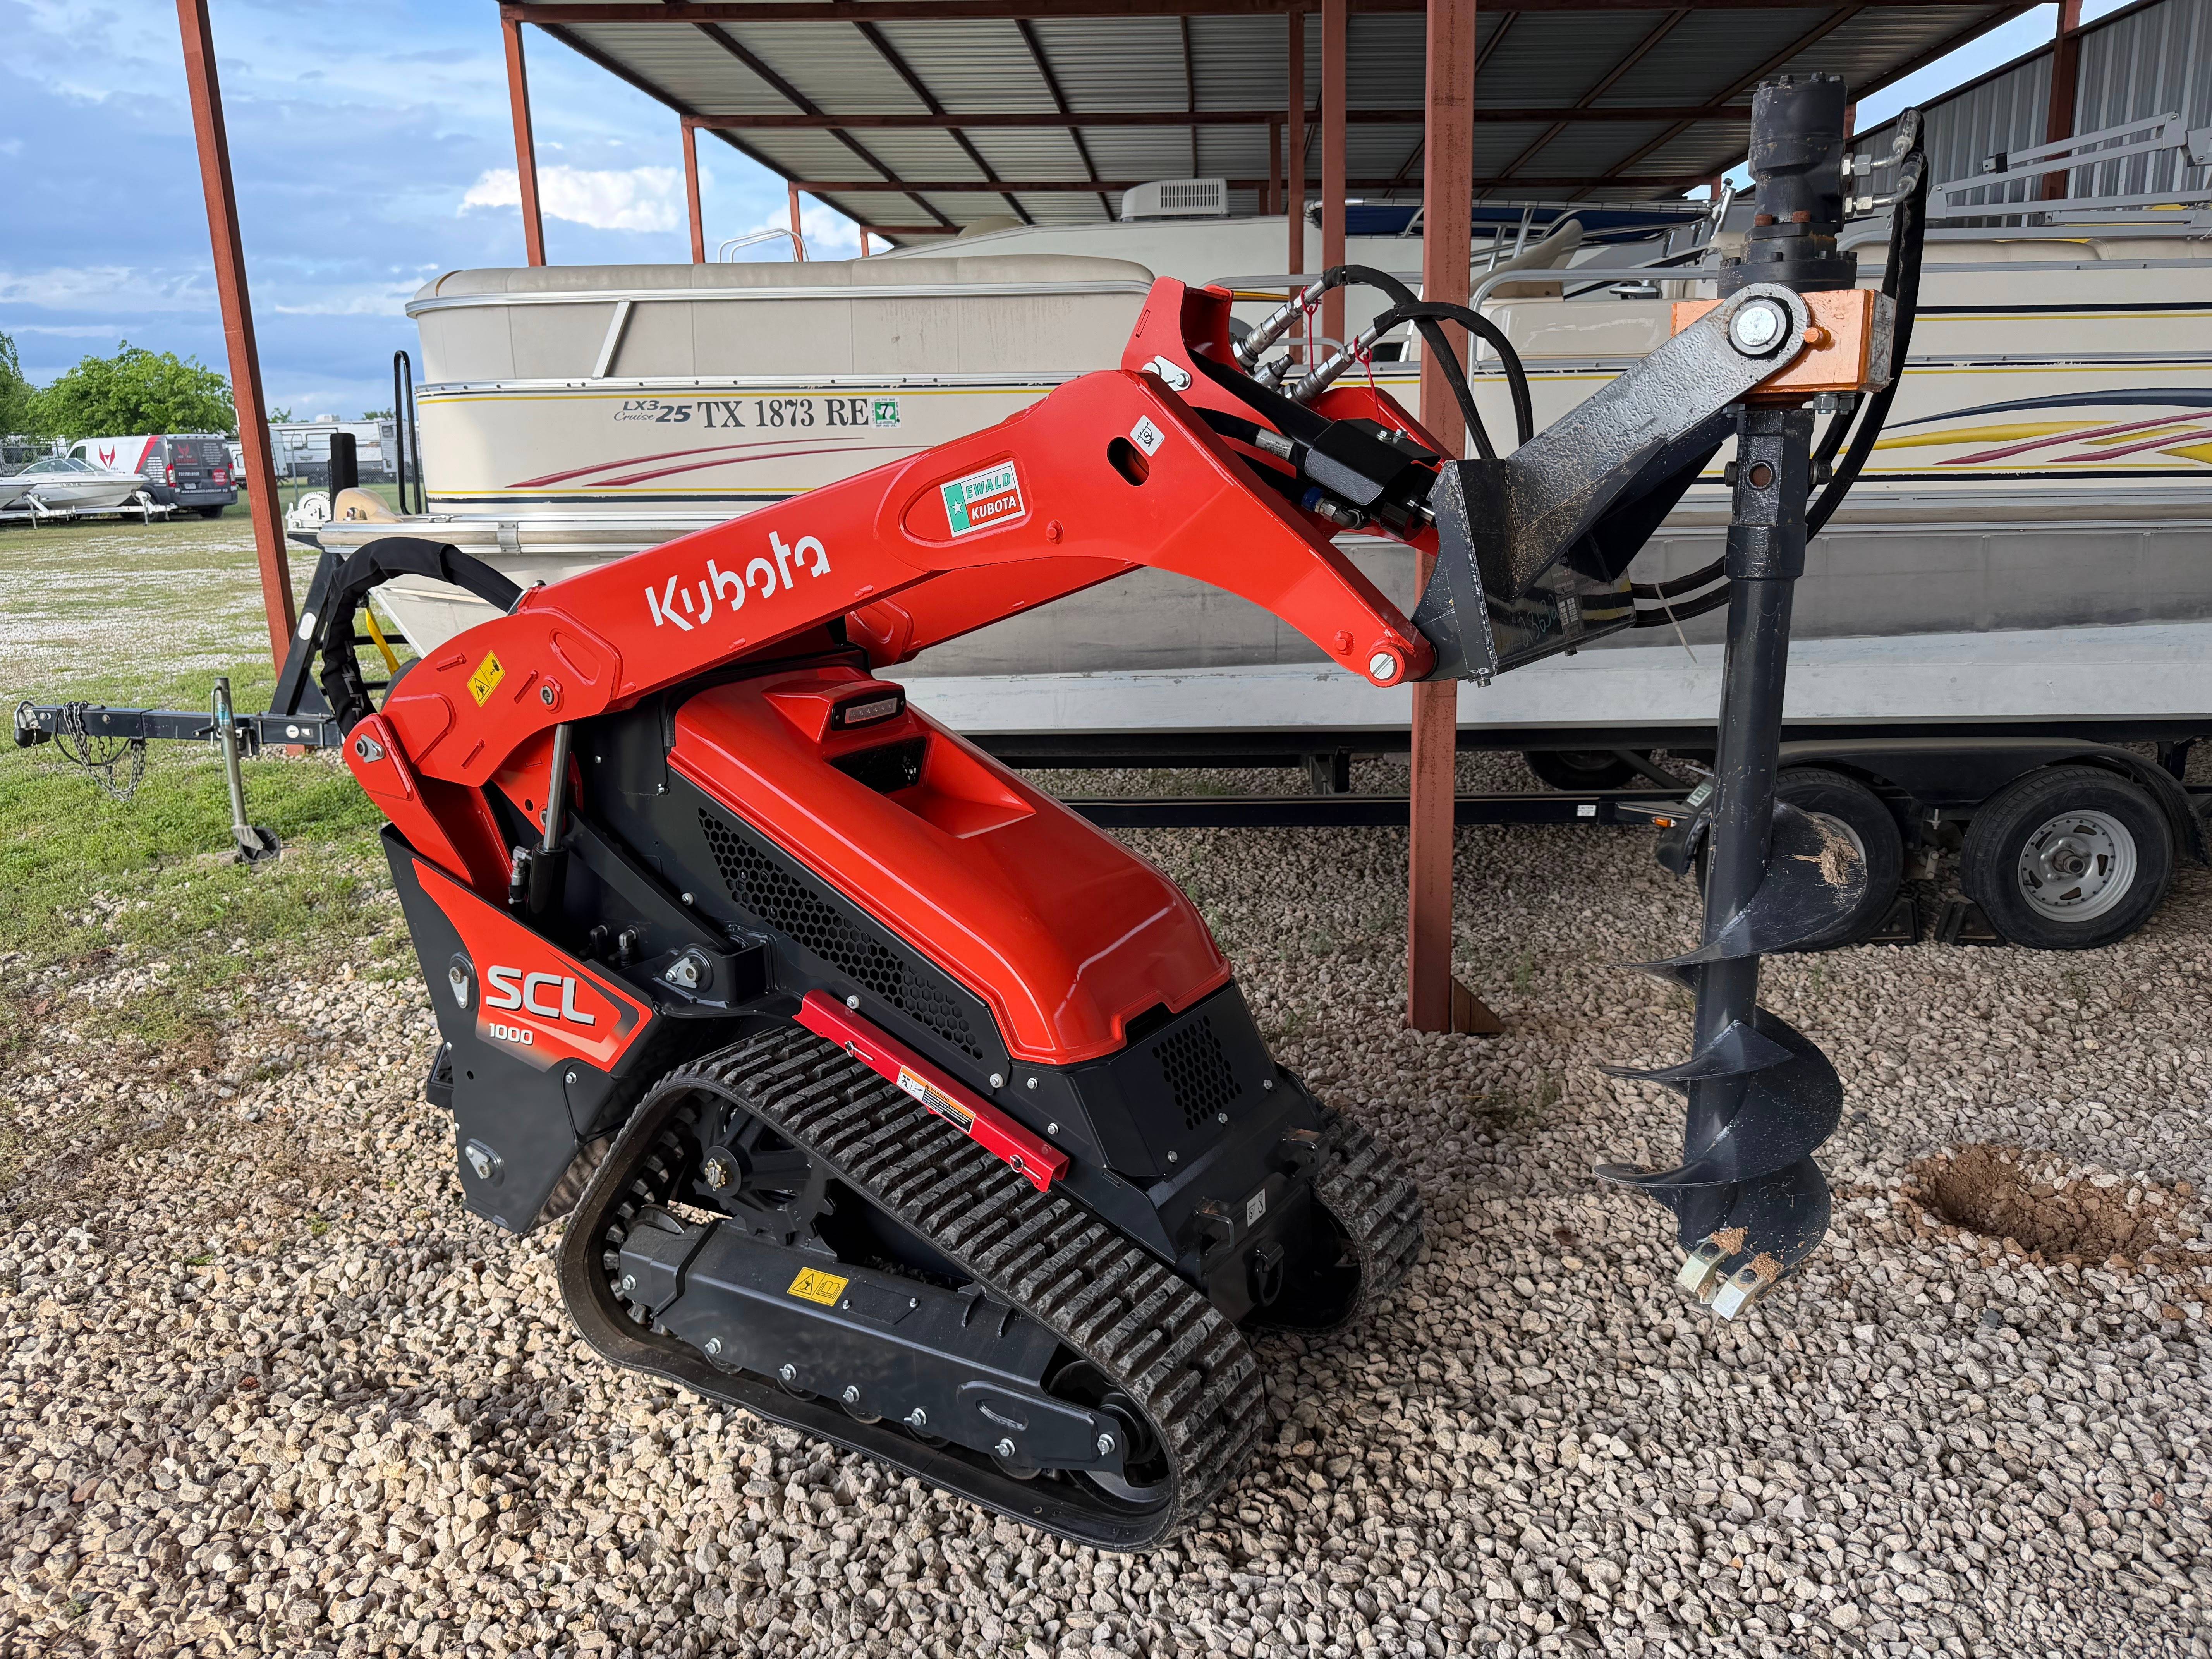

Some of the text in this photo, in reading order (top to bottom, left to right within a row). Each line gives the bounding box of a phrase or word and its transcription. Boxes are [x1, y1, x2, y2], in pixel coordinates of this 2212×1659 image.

[614, 405, 693, 422] Cruise 25
[623, 400, 660, 411] LX3
[697, 400, 746, 428] TX
[754, 399, 814, 427] 1873
[824, 398, 869, 426] RE
[880, 403, 889, 419] 7
[966, 473, 1011, 499] EWALD
[972, 495, 1017, 520] KUBOTA
[644, 531, 831, 632] Kubota
[486, 965, 595, 1026] SCL
[489, 1022, 534, 1045] 1000
